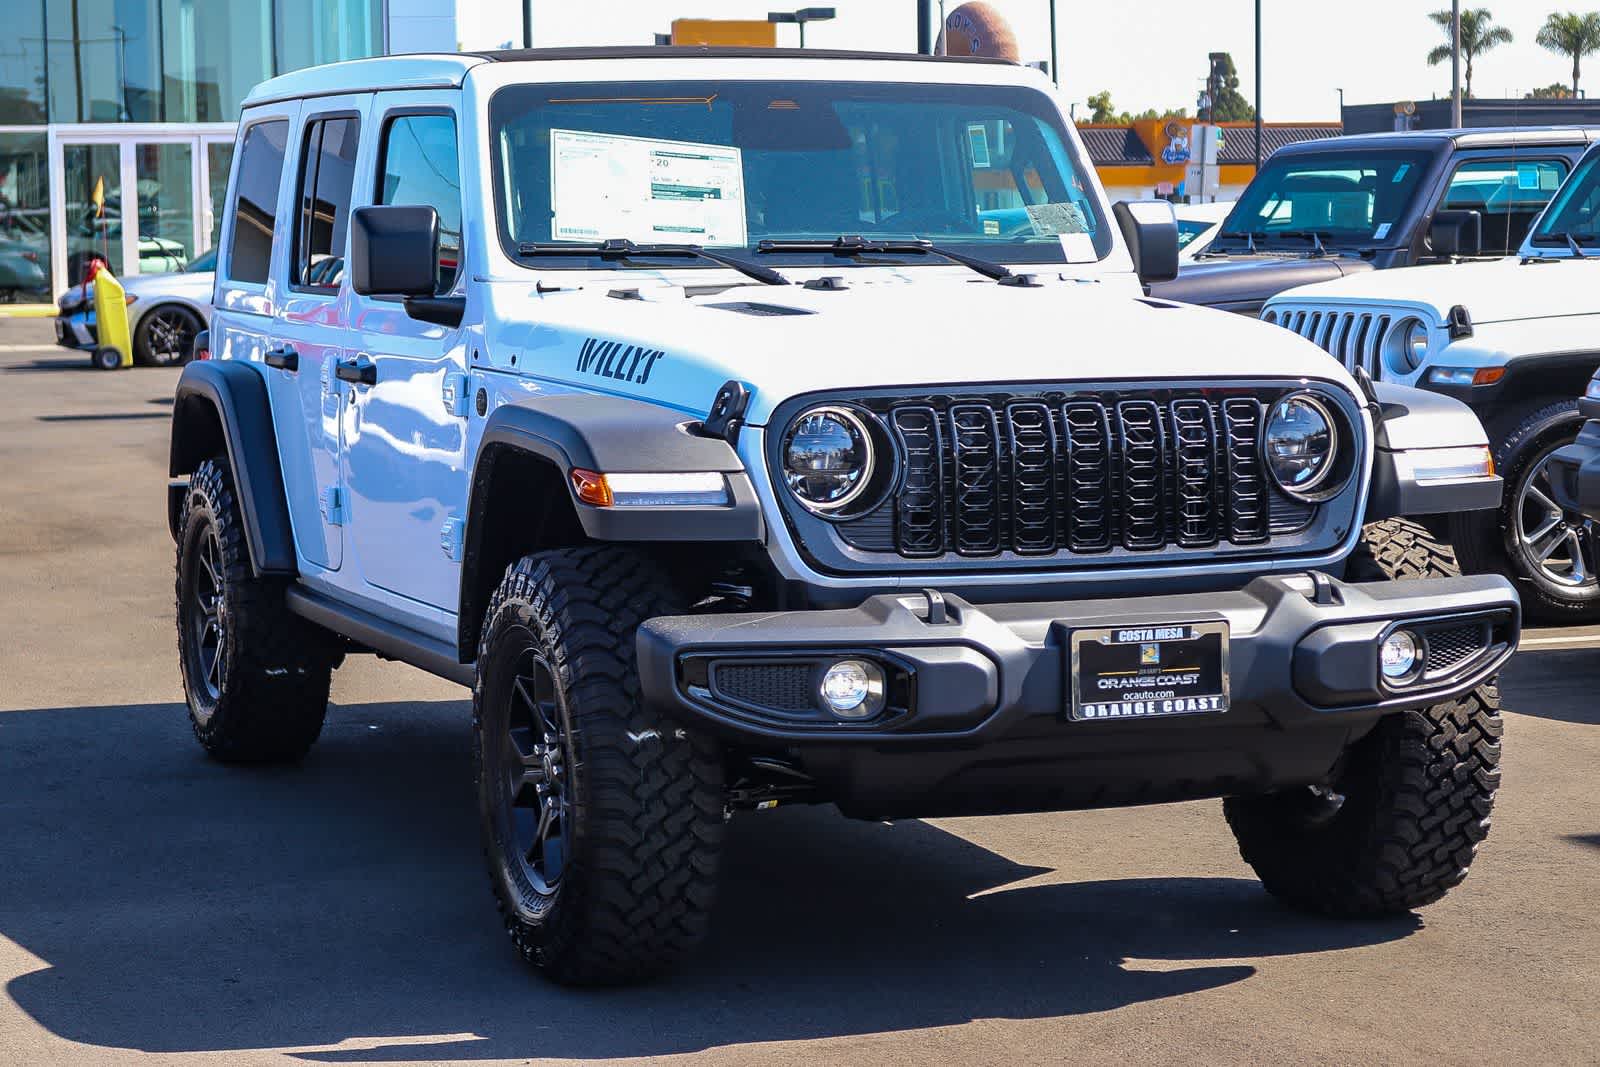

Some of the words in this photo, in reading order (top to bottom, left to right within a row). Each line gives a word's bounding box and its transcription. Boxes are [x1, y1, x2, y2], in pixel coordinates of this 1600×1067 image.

[576, 337, 665, 385] WILLYS
[1118, 629, 1154, 642] COSTA
[1155, 627, 1184, 640] MESA
[1097, 675, 1156, 689] ORANGE
[1156, 673, 1200, 687] COAST
[1123, 689, 1175, 700] ocauto.com
[1084, 701, 1157, 717] ORANGE
[1163, 697, 1220, 713] COAST
